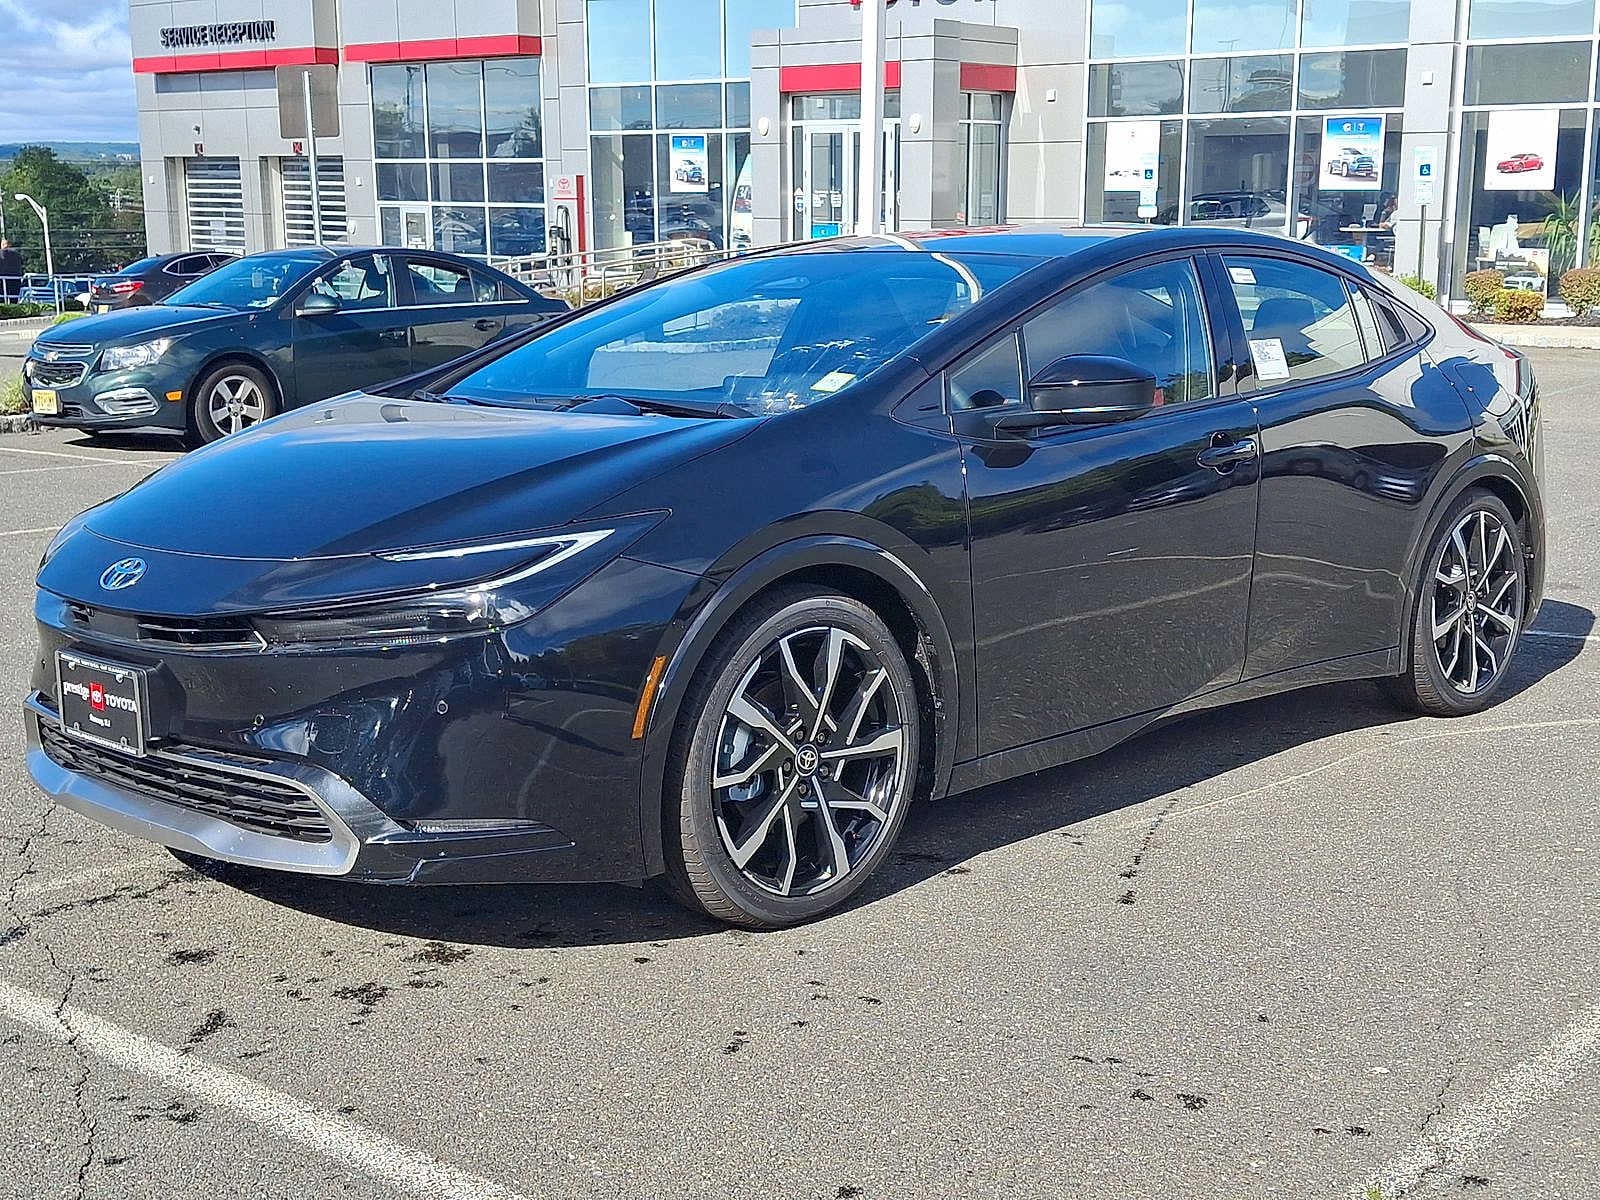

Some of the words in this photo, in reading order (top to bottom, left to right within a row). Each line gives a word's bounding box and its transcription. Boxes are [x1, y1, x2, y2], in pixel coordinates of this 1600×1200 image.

[160, 26, 208, 48] SERVICE
[208, 21, 276, 45] RECEPTION
[104, 693, 137, 712] TOYOTA
